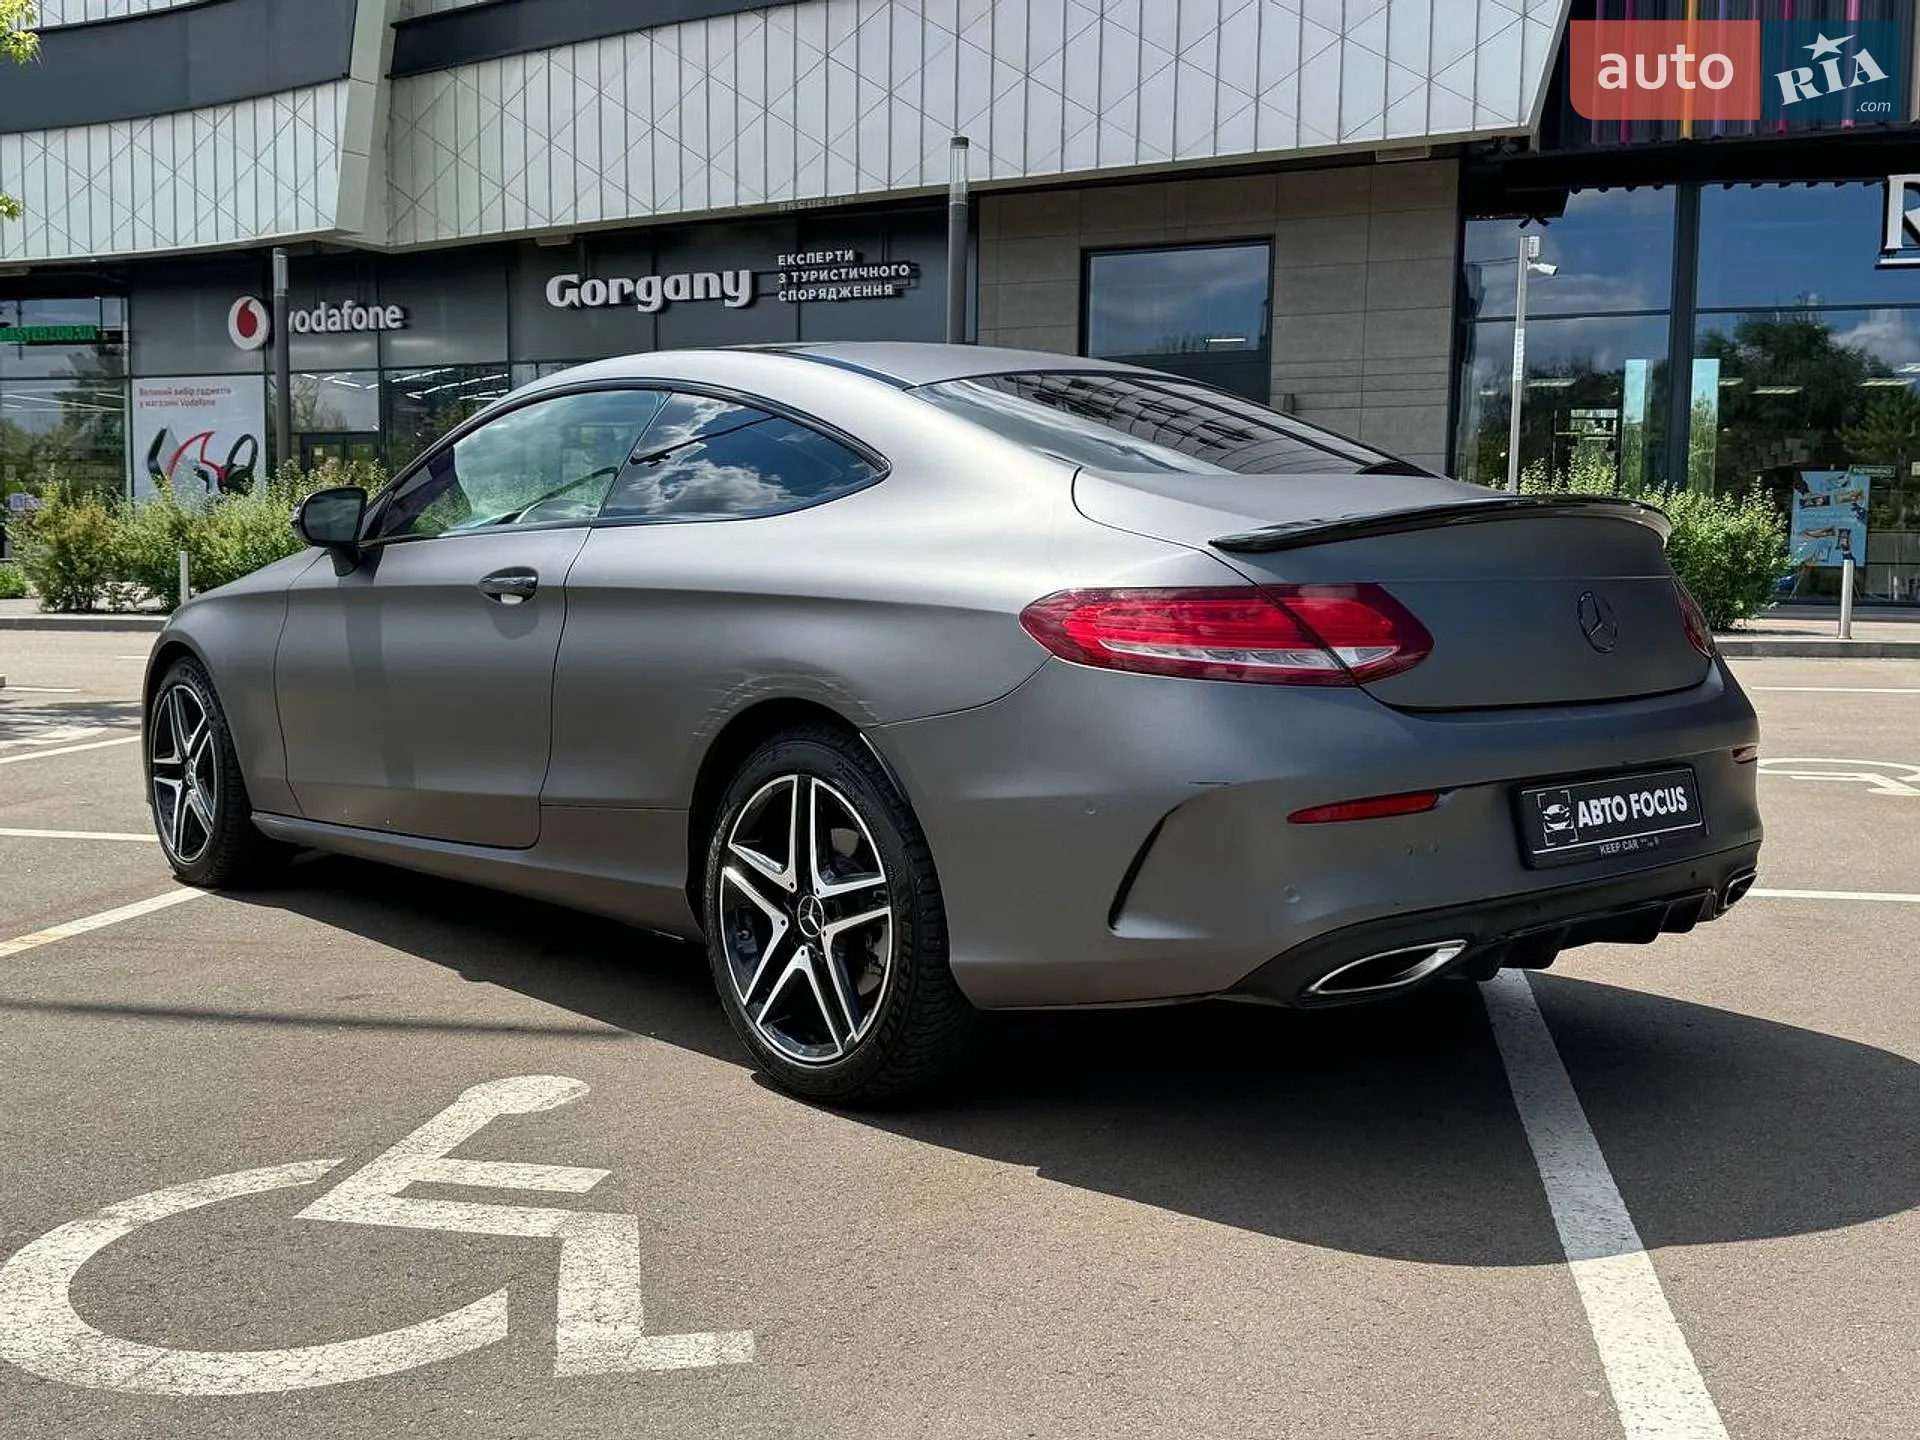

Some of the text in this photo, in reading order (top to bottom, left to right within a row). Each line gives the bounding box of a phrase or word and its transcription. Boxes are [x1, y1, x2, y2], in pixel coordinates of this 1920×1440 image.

[777, 250, 855, 266] ЕКСПЕРТИ
[791, 264, 910, 283] ТУРИСТИЧНОГО
[546, 269, 751, 312] Gorgany
[778, 284, 894, 302] СПОРЯДЖЕННЯ
[1578, 786, 1687, 828] АВТО FOCUS
